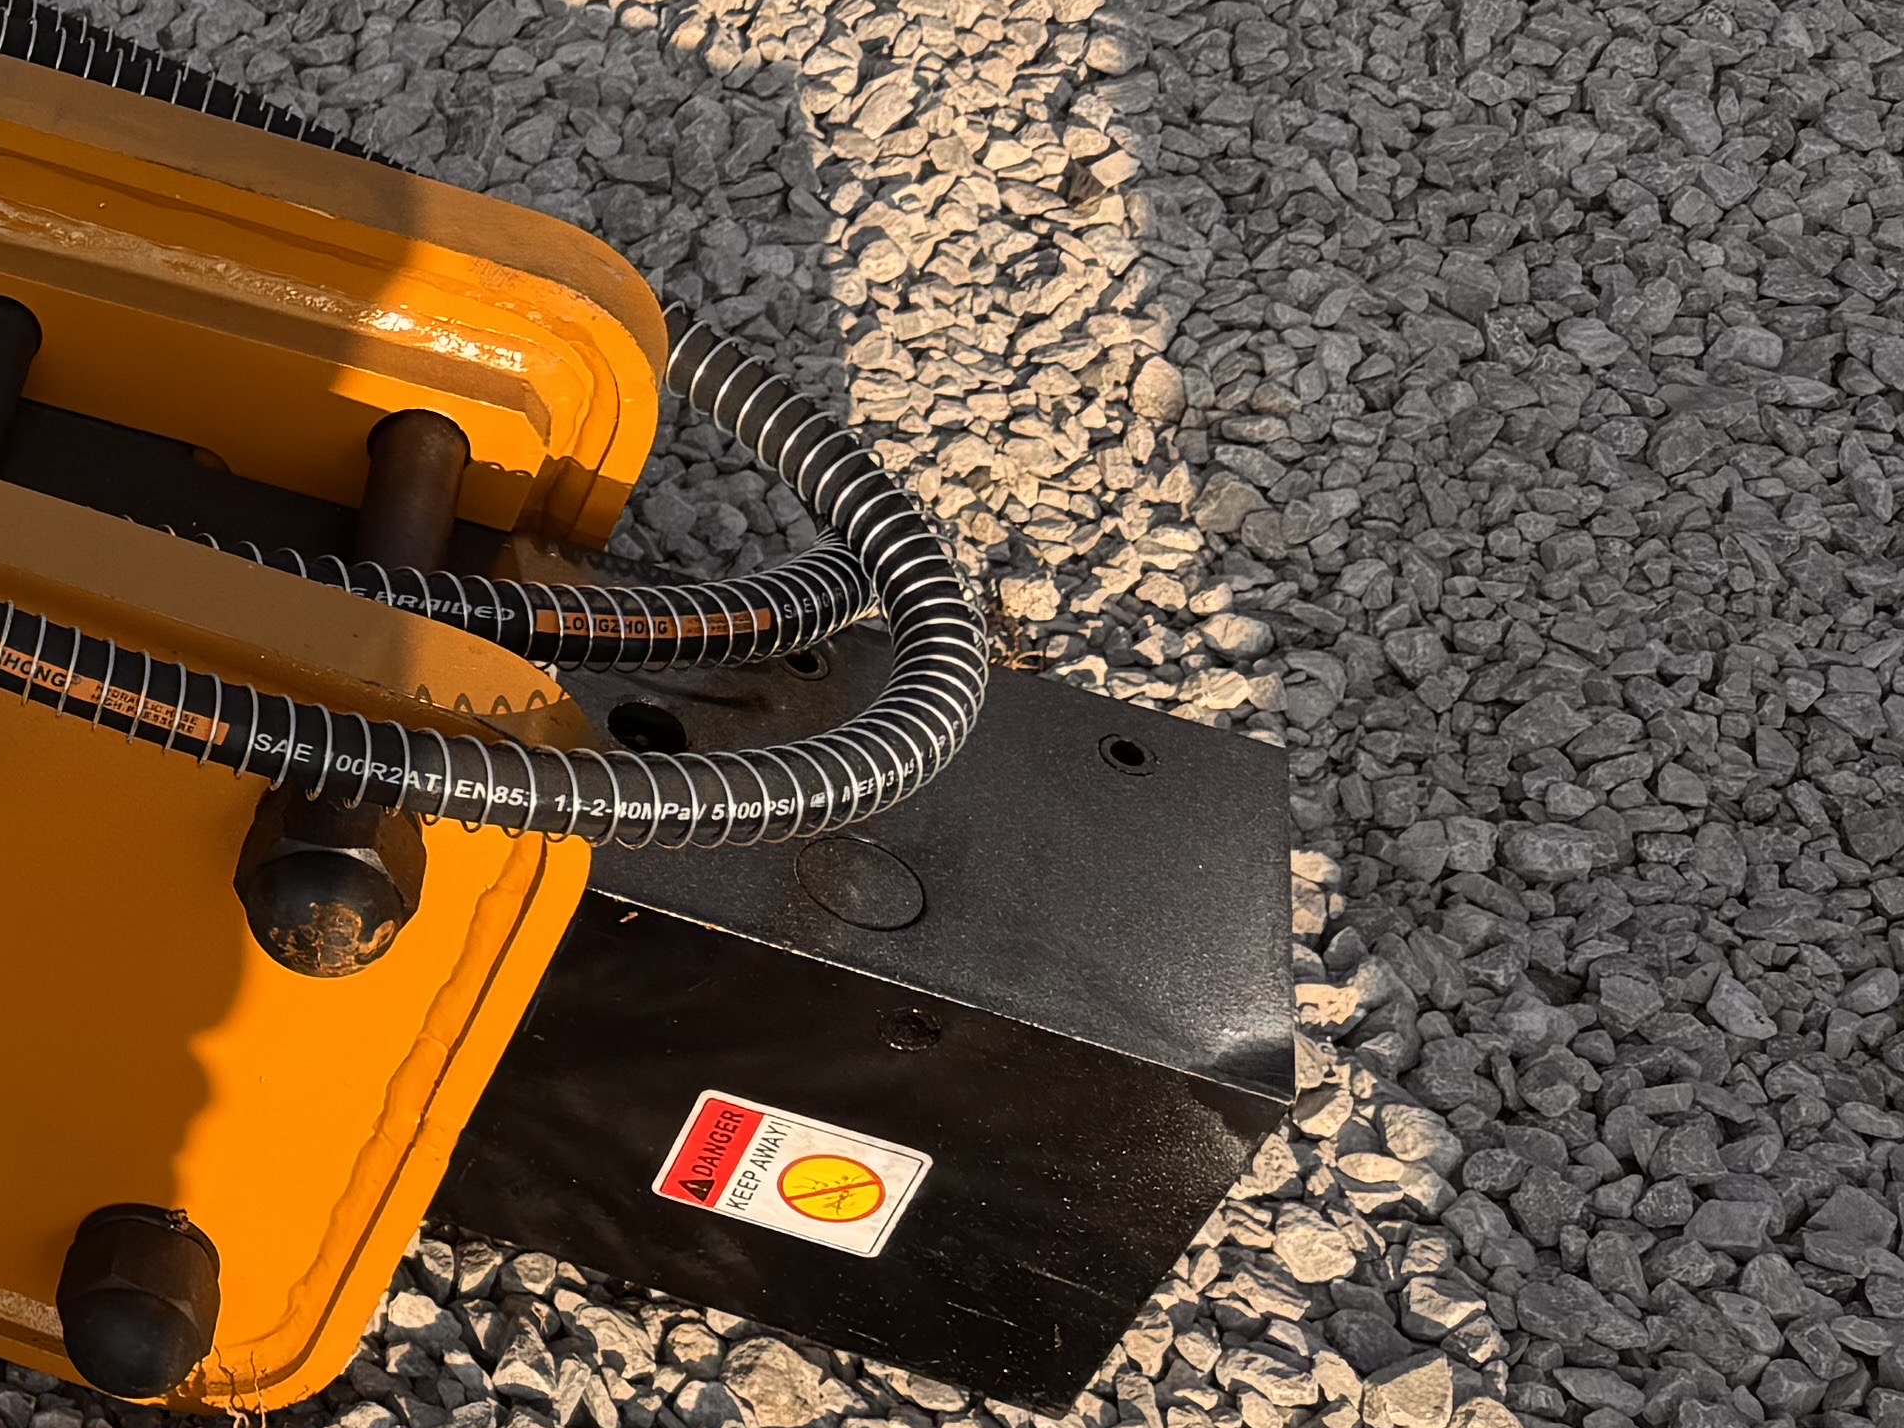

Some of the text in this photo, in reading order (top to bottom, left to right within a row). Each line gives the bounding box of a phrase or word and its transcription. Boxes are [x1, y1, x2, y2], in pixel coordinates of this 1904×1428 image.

[253, 732, 313, 763] SAE
[326, 753, 441, 795] 00R2AT
[711, 795, 795, 822] 500PSI
[693, 1107, 745, 1179] DANGER
[725, 1169, 757, 1212] KEEP
